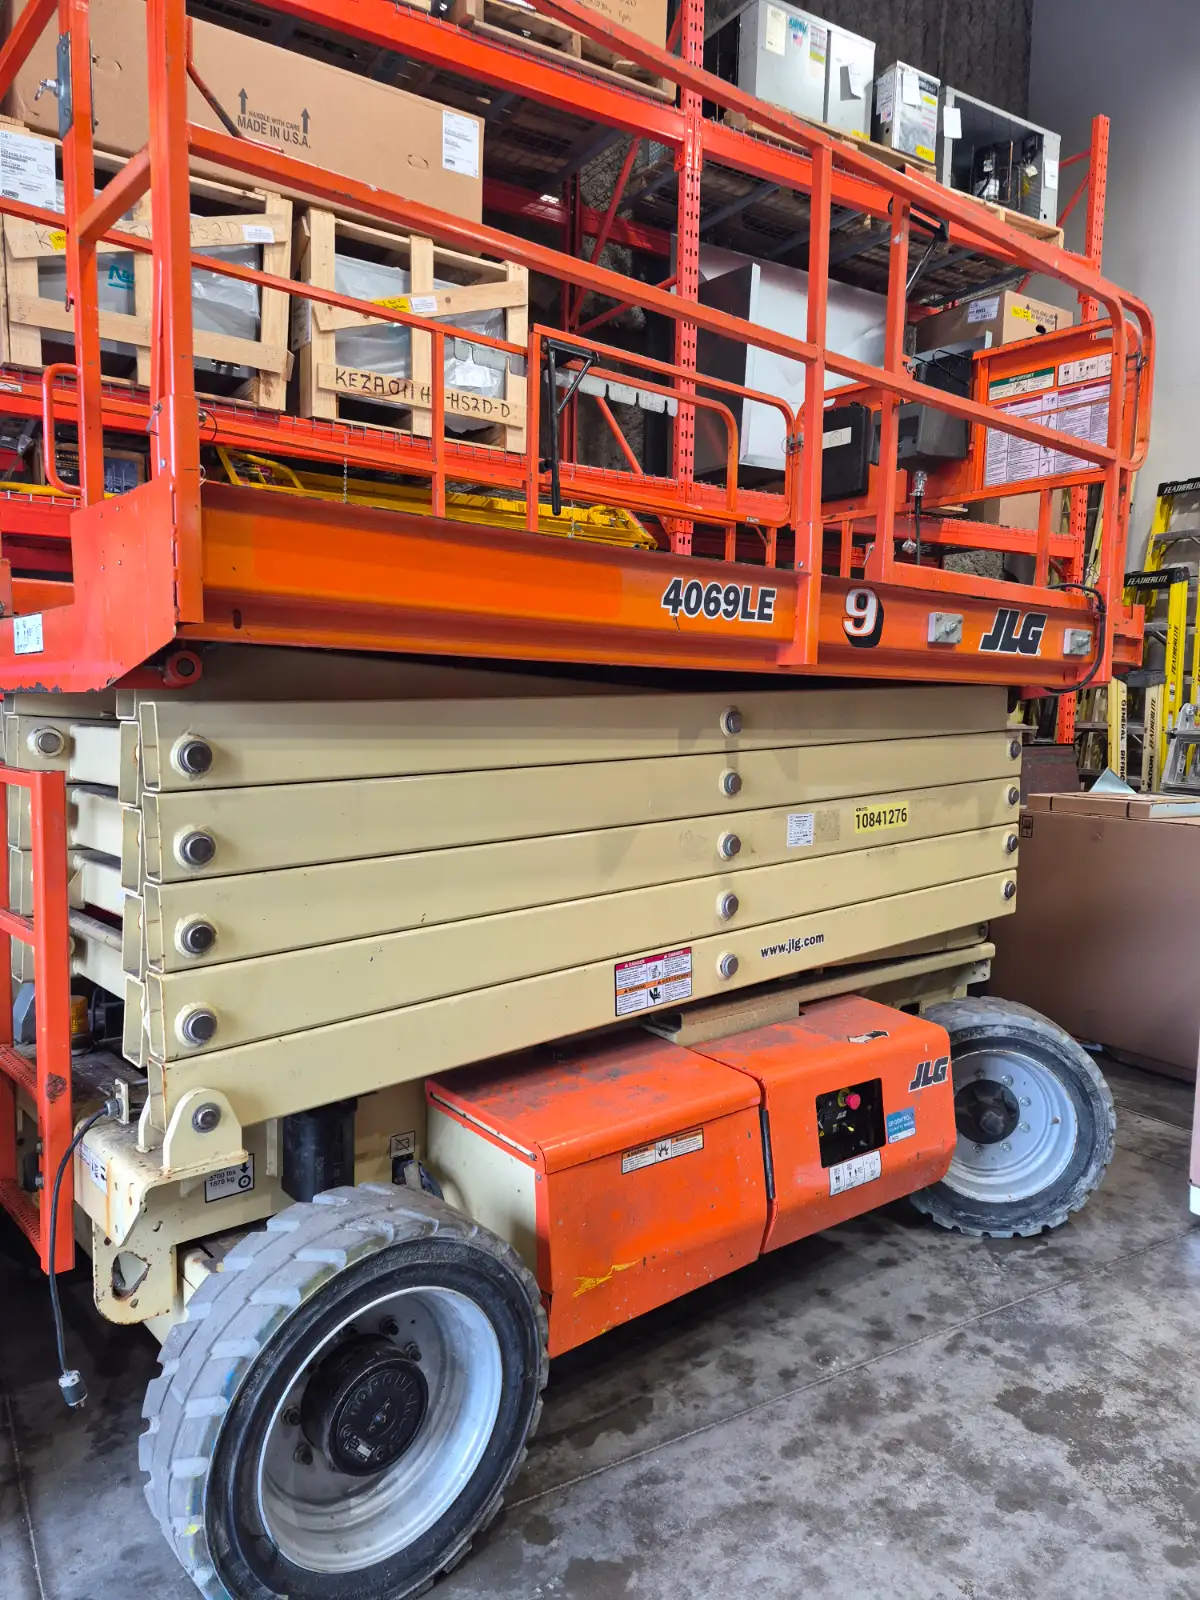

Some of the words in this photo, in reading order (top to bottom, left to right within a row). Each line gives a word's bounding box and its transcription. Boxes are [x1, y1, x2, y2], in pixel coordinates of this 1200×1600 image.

[237, 114, 267, 135] MADE
[269, 125, 280, 139] IN
[283, 129, 312, 149] U.S.A.
[248, 110, 270, 122] HANDLE
[271, 117, 284, 127] WITH
[285, 121, 300, 132] CARE
[1127, 575, 1168, 586] FEATHERLITE
[661, 577, 777, 623] 4069LE
[842, 586, 884, 648] 9
[979, 608, 1048, 656] JLG
[1171, 625, 1179, 675] FEATHERLITE
[1148, 698, 1156, 749] FEATHERLITE
[855, 807, 908, 829] 10841276
[760, 933, 824, 958] www.jlg.com
[908, 1056, 949, 1092] JLG
[208, 1172, 225, 1182] 3700
[226, 1176, 235, 1184] kg
